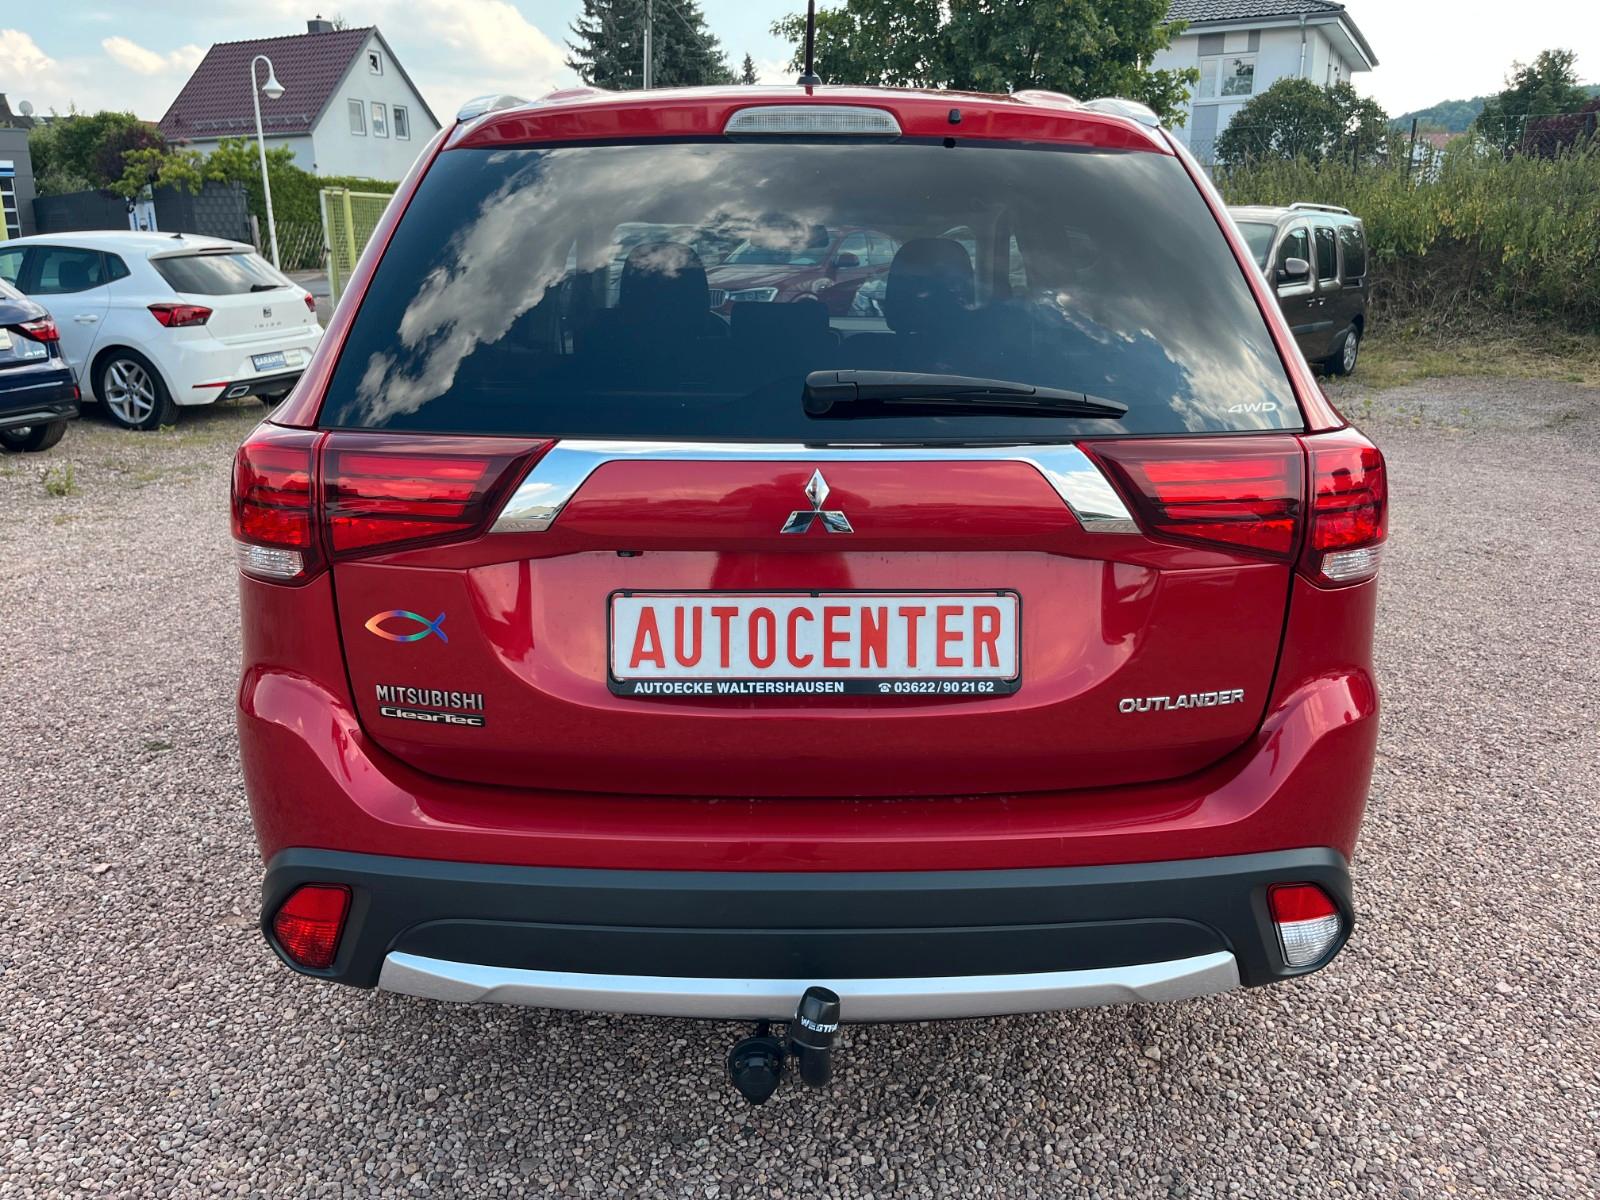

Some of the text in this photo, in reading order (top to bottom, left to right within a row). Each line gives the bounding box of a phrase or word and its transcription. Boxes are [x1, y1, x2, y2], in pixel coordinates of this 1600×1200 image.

[1228, 402, 1277, 413] 4WD
[629, 606, 1001, 669] AUTOCENTER
[375, 684, 483, 710] MITSUBISHI
[634, 682, 844, 694] AUTOECKE WALTERSHAUSEN
[1119, 688, 1245, 713] OUTLANDER
[380, 707, 482, 726] ClearTec
